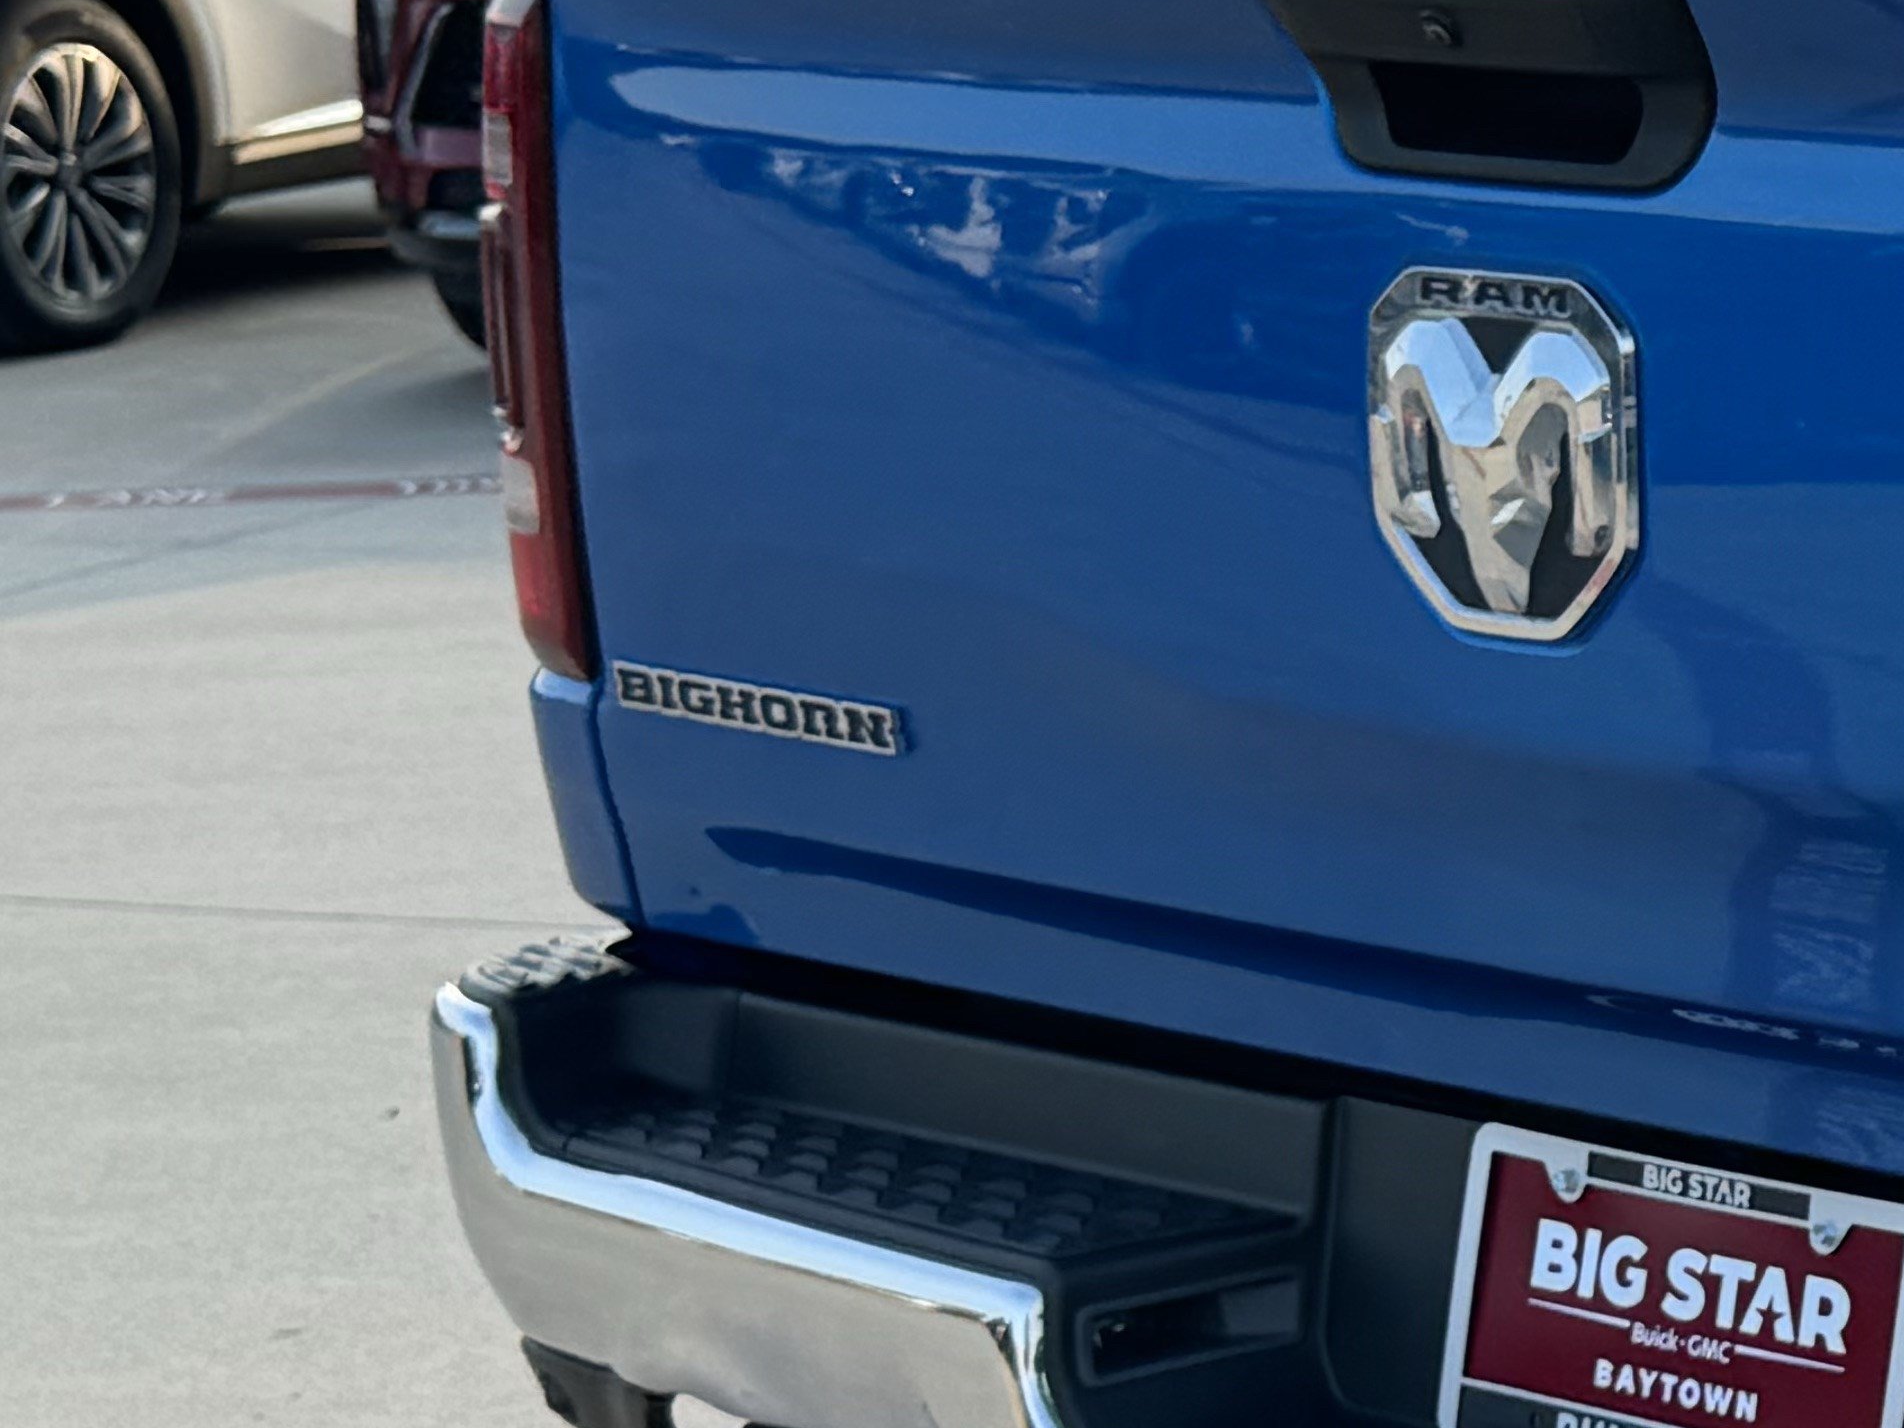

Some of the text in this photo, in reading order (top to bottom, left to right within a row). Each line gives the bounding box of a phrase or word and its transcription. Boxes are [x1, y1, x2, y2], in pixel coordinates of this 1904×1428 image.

[1420, 276, 1571, 318] RAM
[614, 661, 896, 755] BIGHORN
[1641, 1163, 1752, 1210] BIG STAR
[1529, 1218, 1851, 1354] BIG STAR
[1593, 1358, 1757, 1422] BAYTOWN
